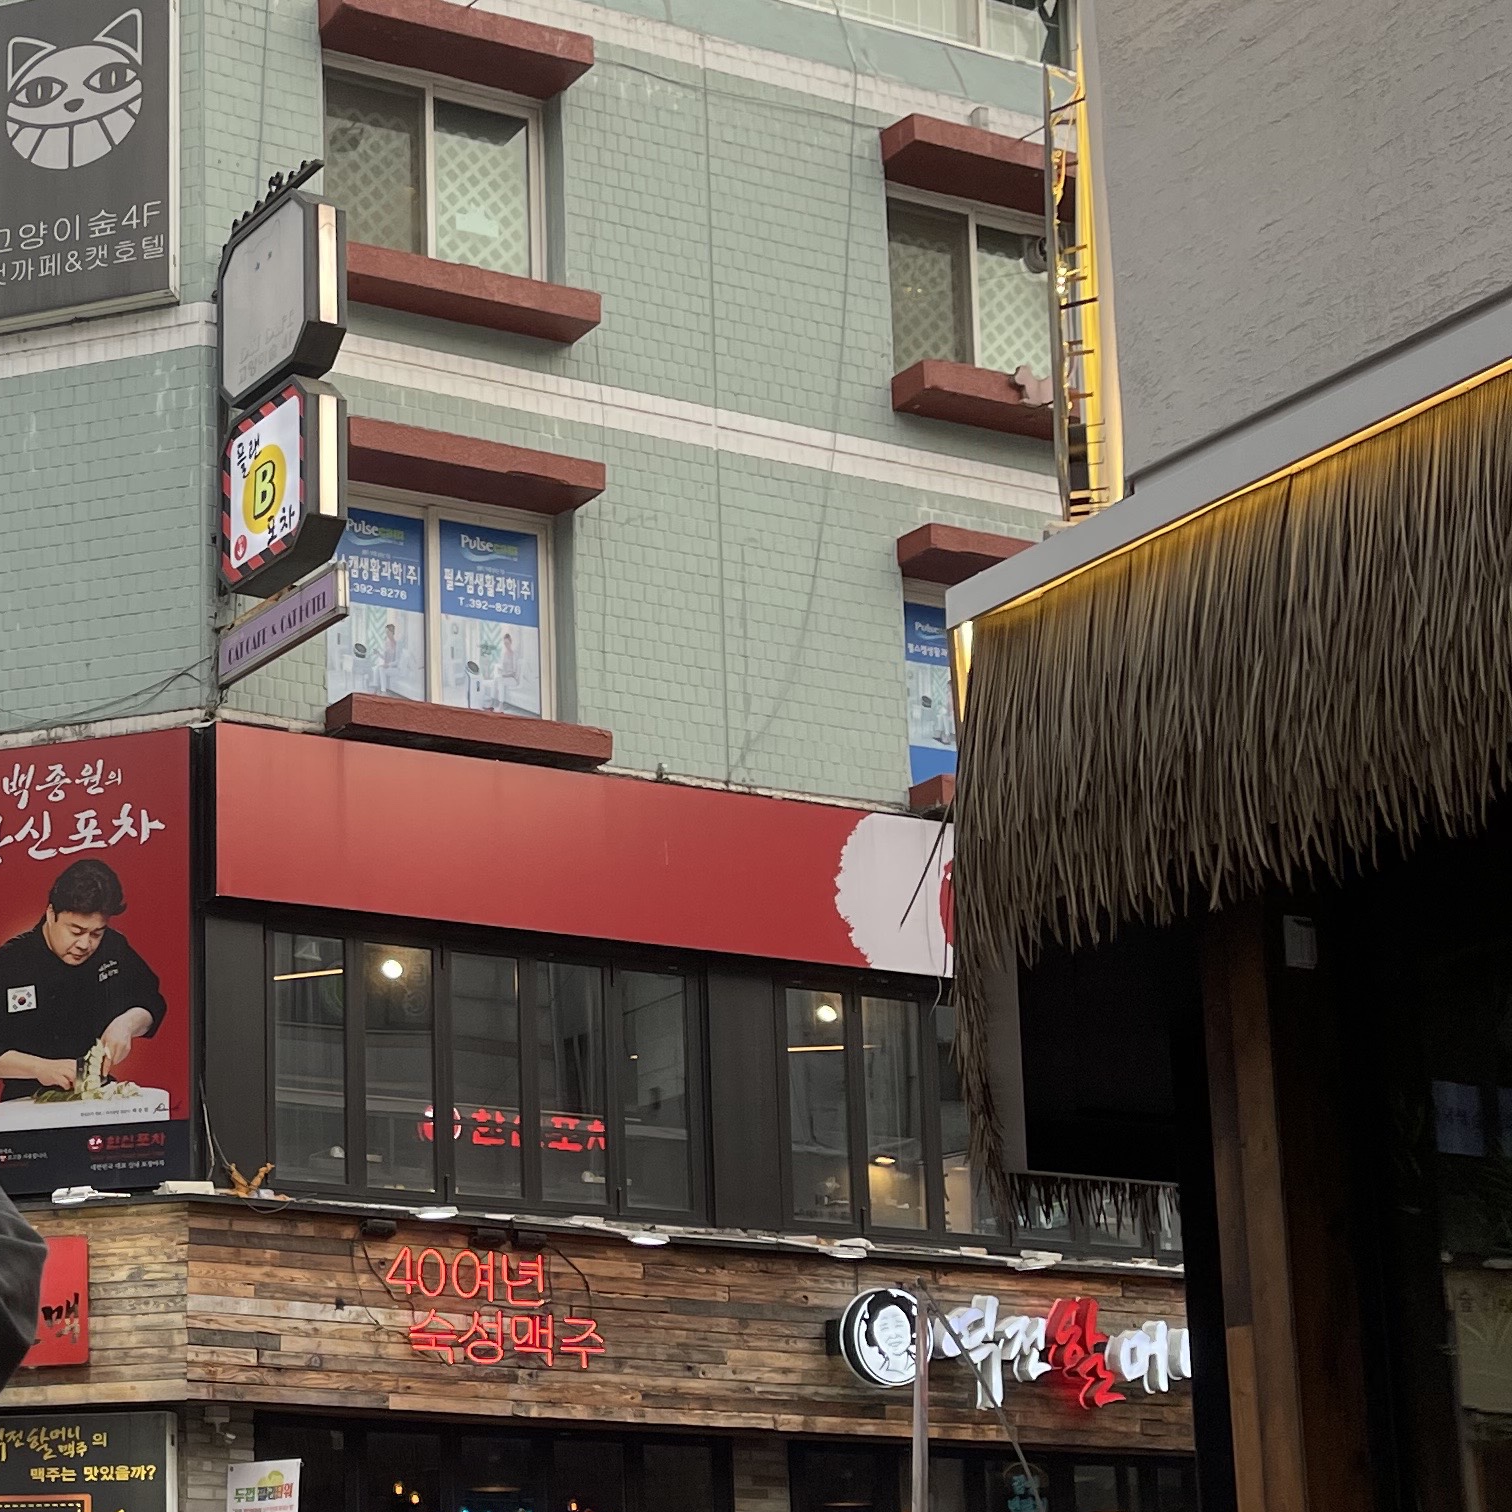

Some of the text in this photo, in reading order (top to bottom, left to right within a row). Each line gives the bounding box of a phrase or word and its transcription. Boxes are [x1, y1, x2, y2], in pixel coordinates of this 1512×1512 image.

[236, 434, 262, 478] 플랜
[253, 459, 276, 520] B
[266, 504, 296, 543] 포차
[2, 758, 122, 810] 백종원의
[386, 1246, 545, 1307] 40여년
[409, 1308, 606, 1369] 숙성맥주
[92, 1432, 108, 1448] 의
[30, 1464, 157, 1483] 맥주는 맛있을까?
